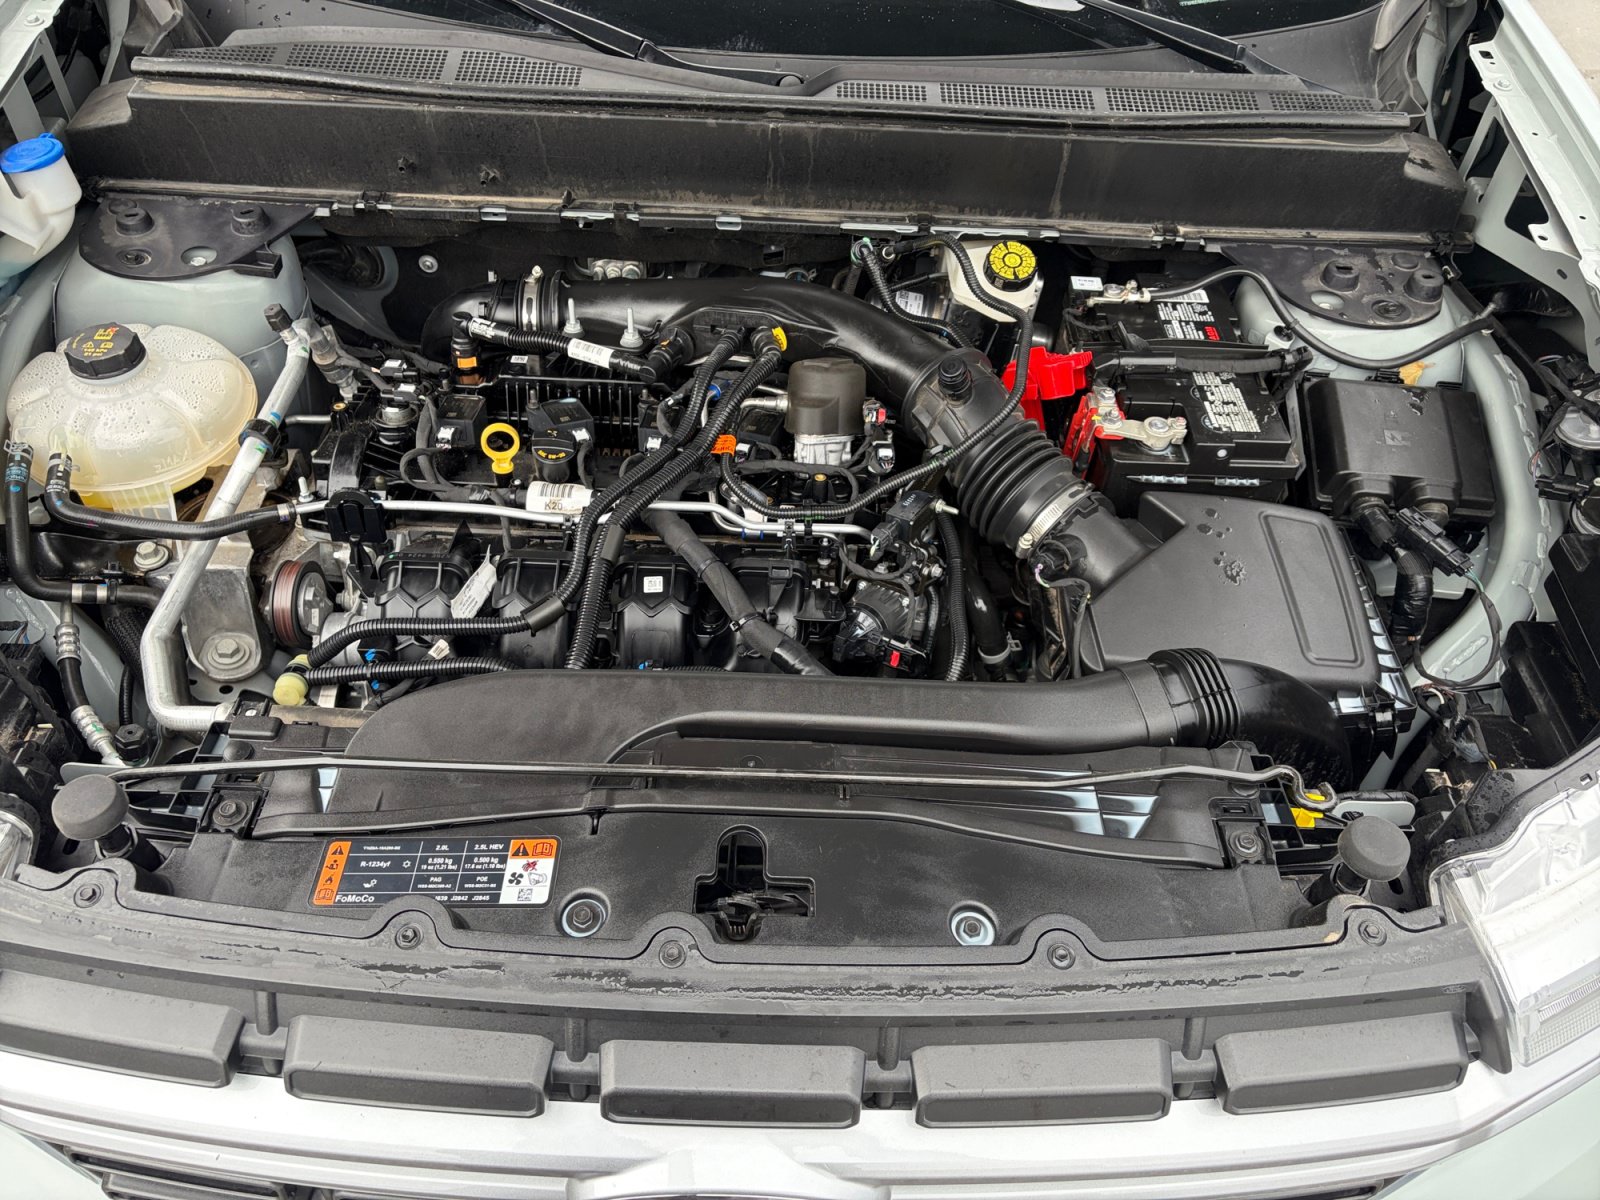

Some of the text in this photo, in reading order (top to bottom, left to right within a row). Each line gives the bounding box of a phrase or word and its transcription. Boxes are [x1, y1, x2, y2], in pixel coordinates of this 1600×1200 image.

[544, 501, 563, 511] K20
[360, 861, 391, 869] R-1234yf
[445, 857, 453, 865] kg
[335, 894, 375, 902] FoMoCo
